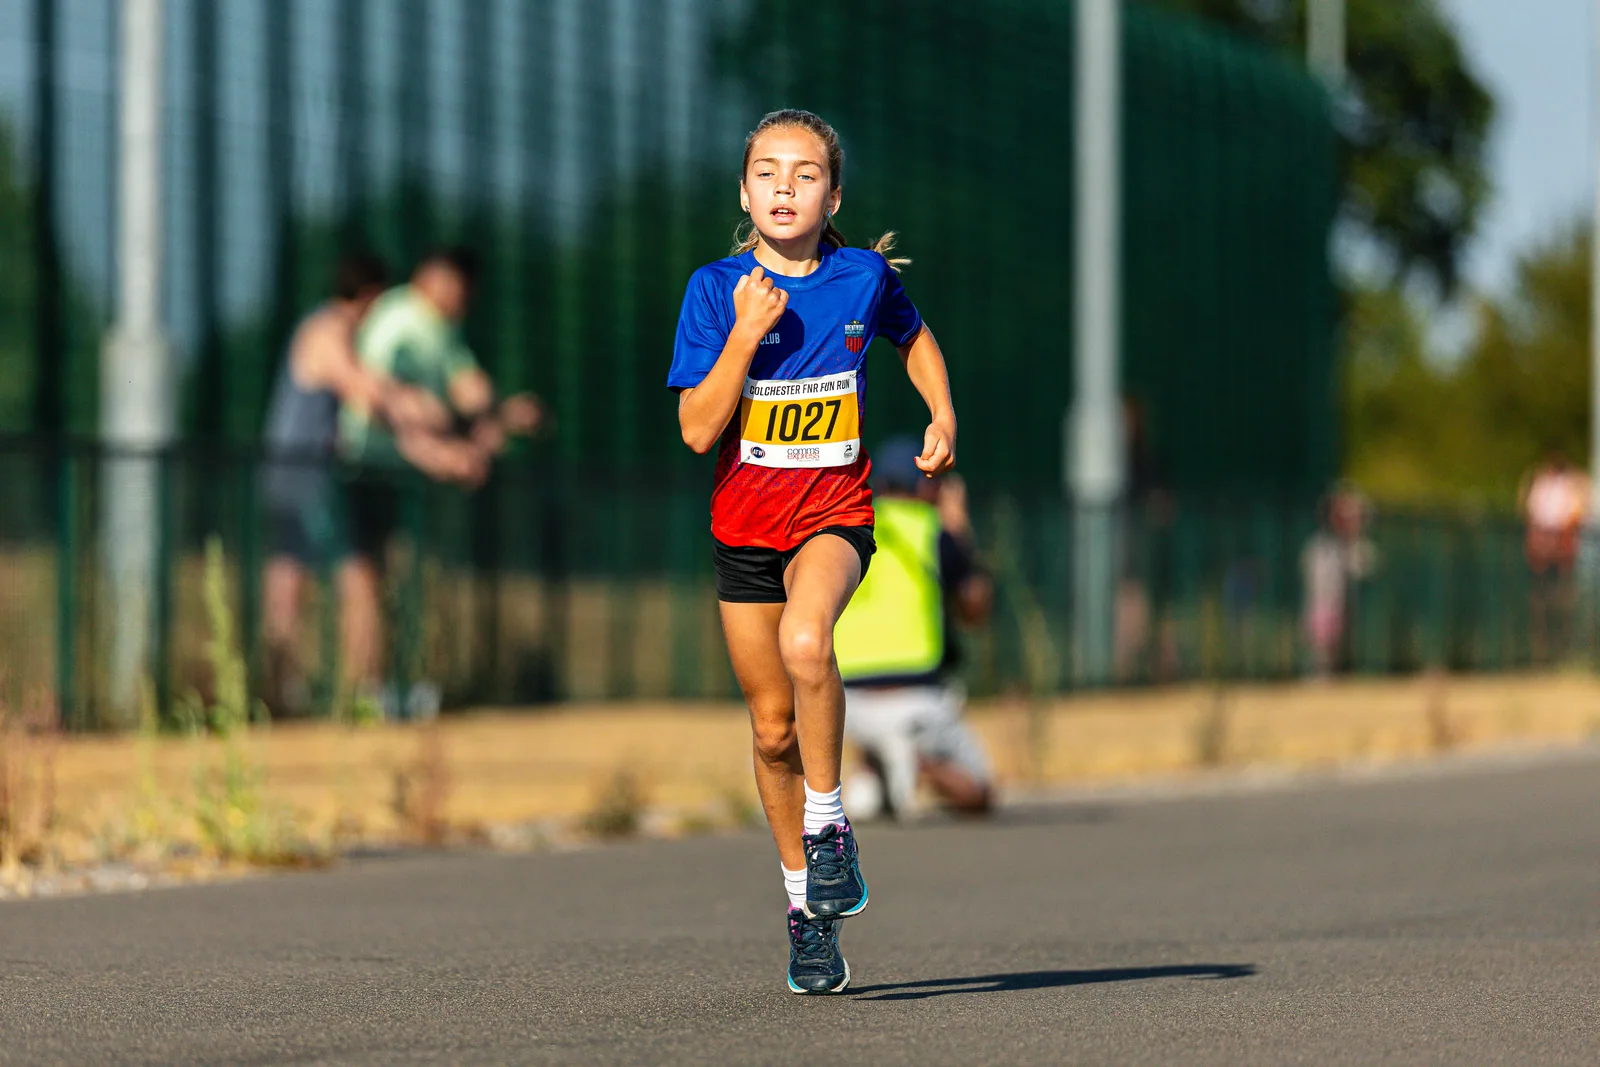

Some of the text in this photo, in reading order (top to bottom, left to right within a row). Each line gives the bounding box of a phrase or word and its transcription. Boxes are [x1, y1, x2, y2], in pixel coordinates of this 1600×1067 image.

[750, 379, 850, 396] COLCHESTER FNR FUN RUN
[765, 399, 842, 442] 1027
[787, 447, 820, 455] comms
[787, 453, 820, 461] express
